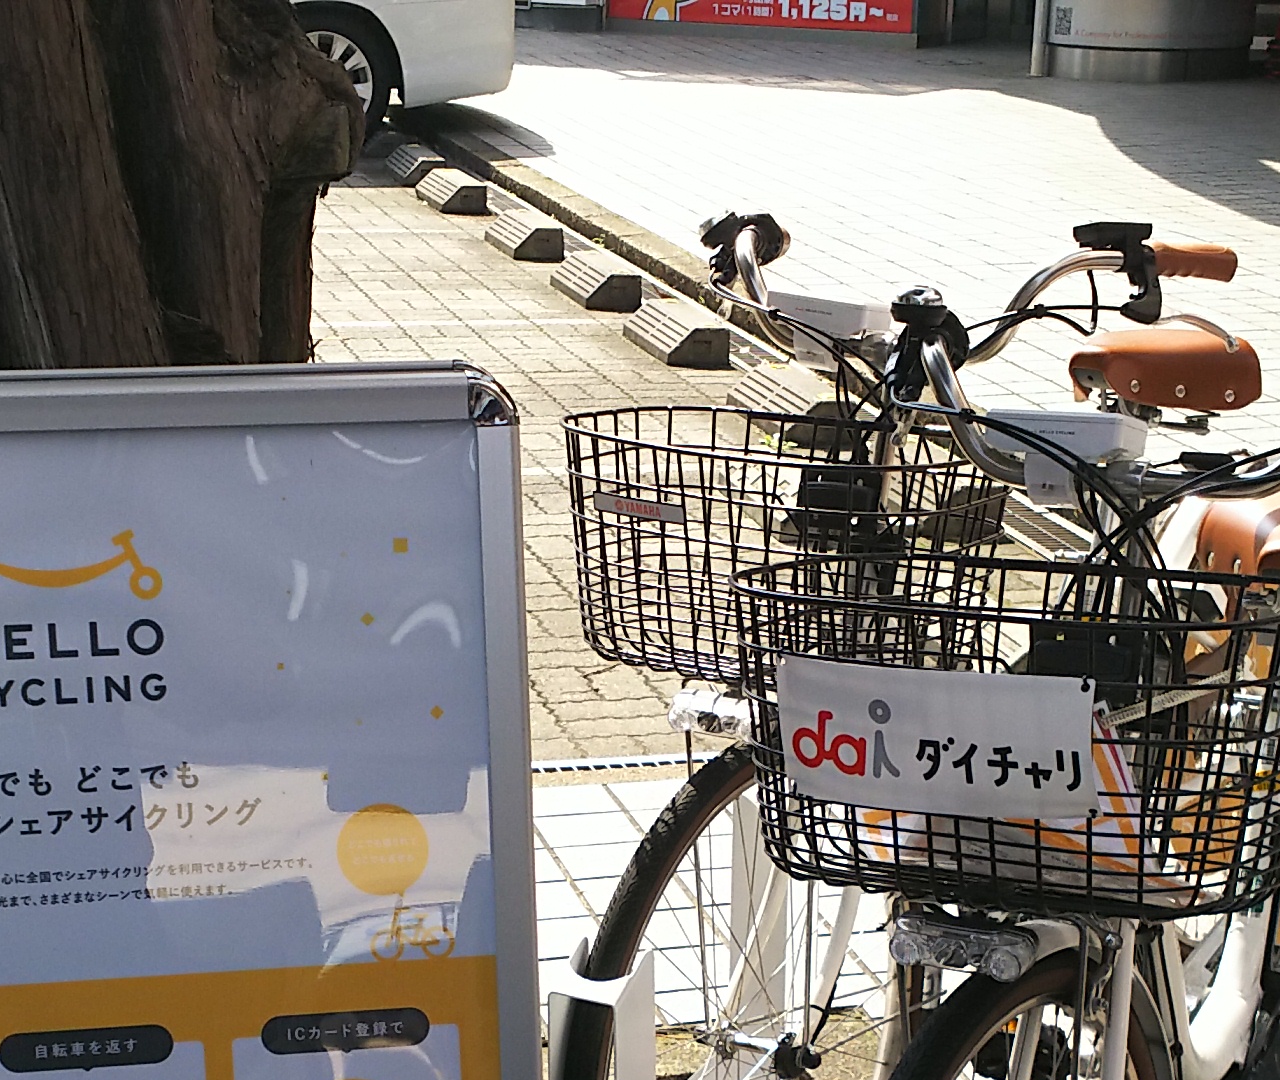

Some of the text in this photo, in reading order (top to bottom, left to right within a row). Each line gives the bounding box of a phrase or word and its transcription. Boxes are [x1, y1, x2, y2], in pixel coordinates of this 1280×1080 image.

[624, 501, 661, 518] YAMAHA
[792, 699, 900, 779] dai
[76, 761, 201, 793] どこでも
[916, 736, 1082, 792] ダイチャリ
[287, 1021, 404, 1041] ICカード登録で
[34, 1038, 138, 1059] 自転車を返す
